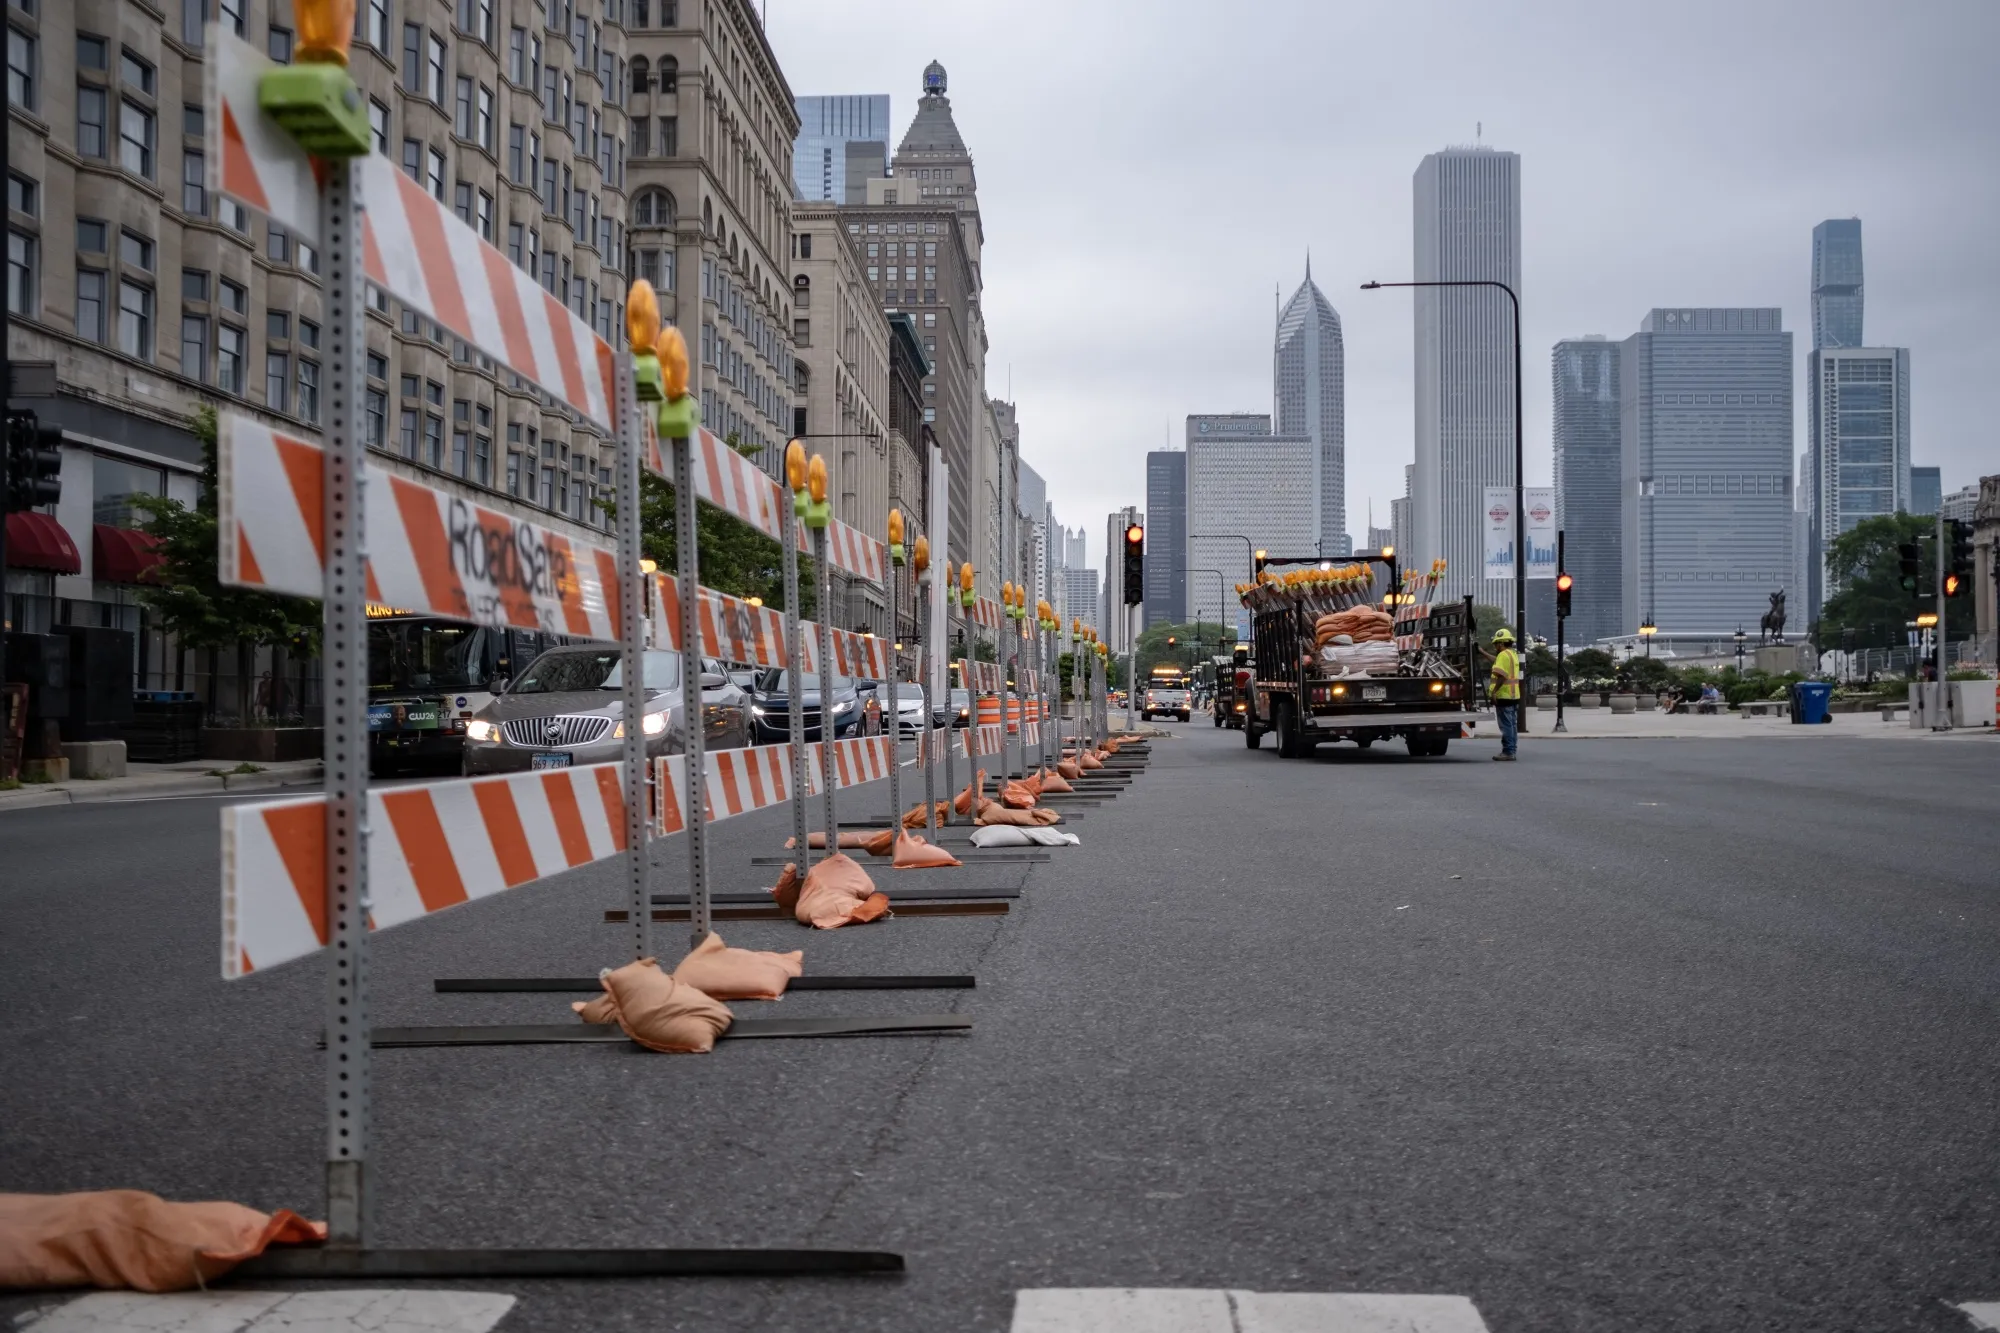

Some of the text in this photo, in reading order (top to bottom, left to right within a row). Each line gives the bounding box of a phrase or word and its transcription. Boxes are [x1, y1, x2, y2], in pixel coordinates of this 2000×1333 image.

[449, 497, 566, 601] RoadSafe
[366, 603, 392, 617] KING
[408, 712, 435, 721] CW26
[532, 759, 570, 770] 969 2316
